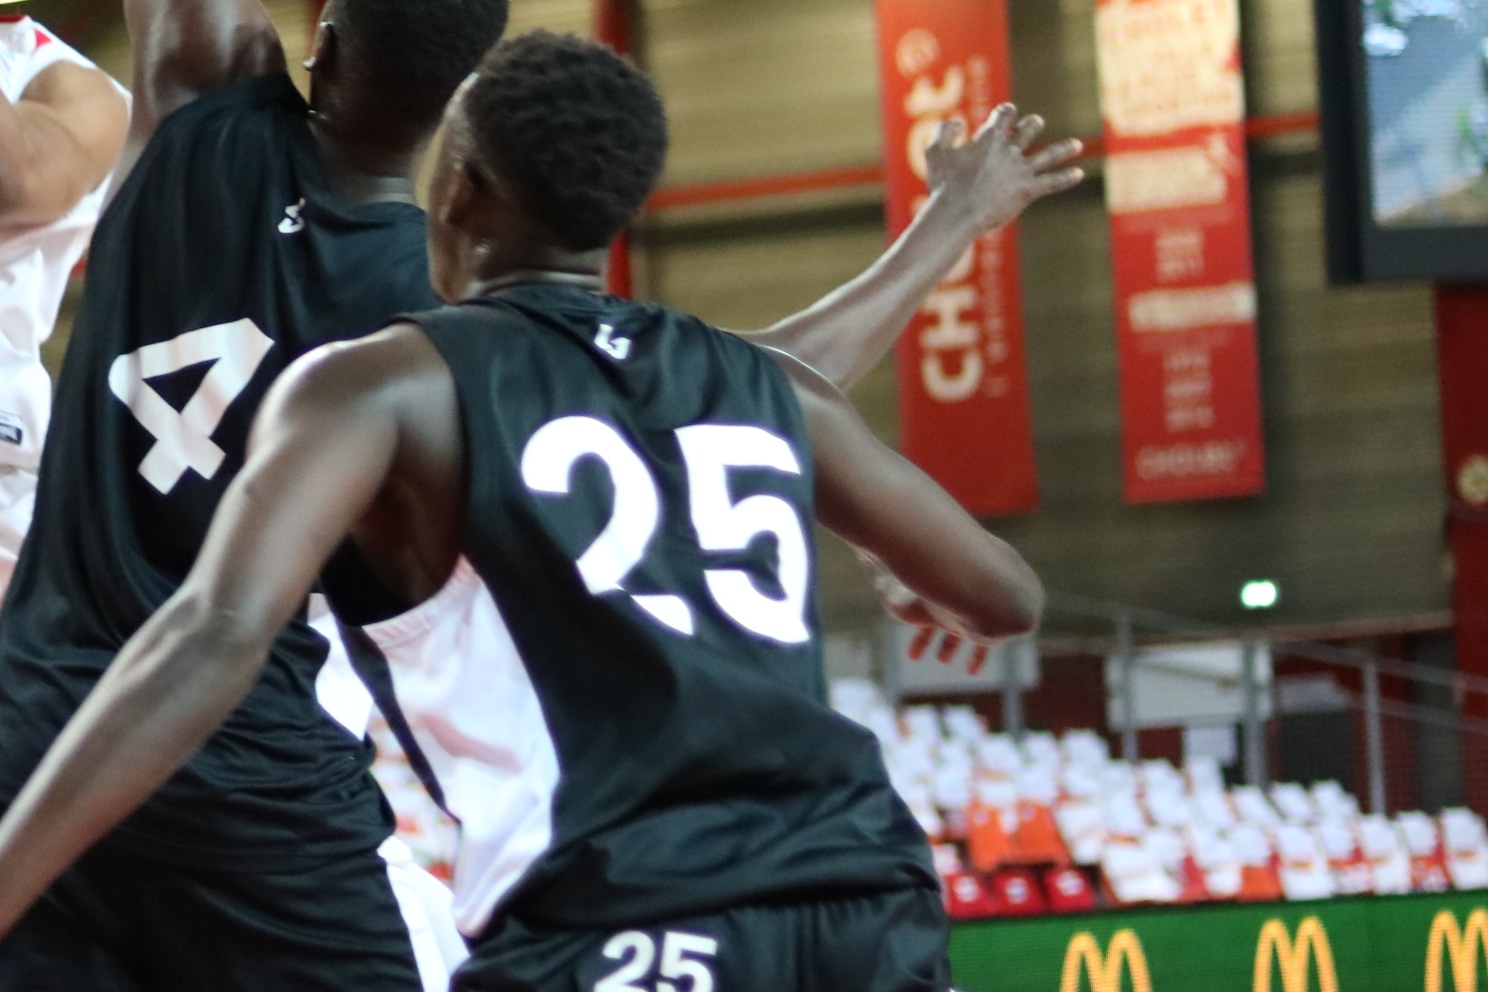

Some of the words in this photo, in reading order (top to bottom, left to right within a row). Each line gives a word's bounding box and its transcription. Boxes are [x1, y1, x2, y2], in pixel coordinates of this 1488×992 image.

[108, 317, 275, 495] 4
[520, 416, 810, 644] 25
[594, 930, 718, 992] 25
